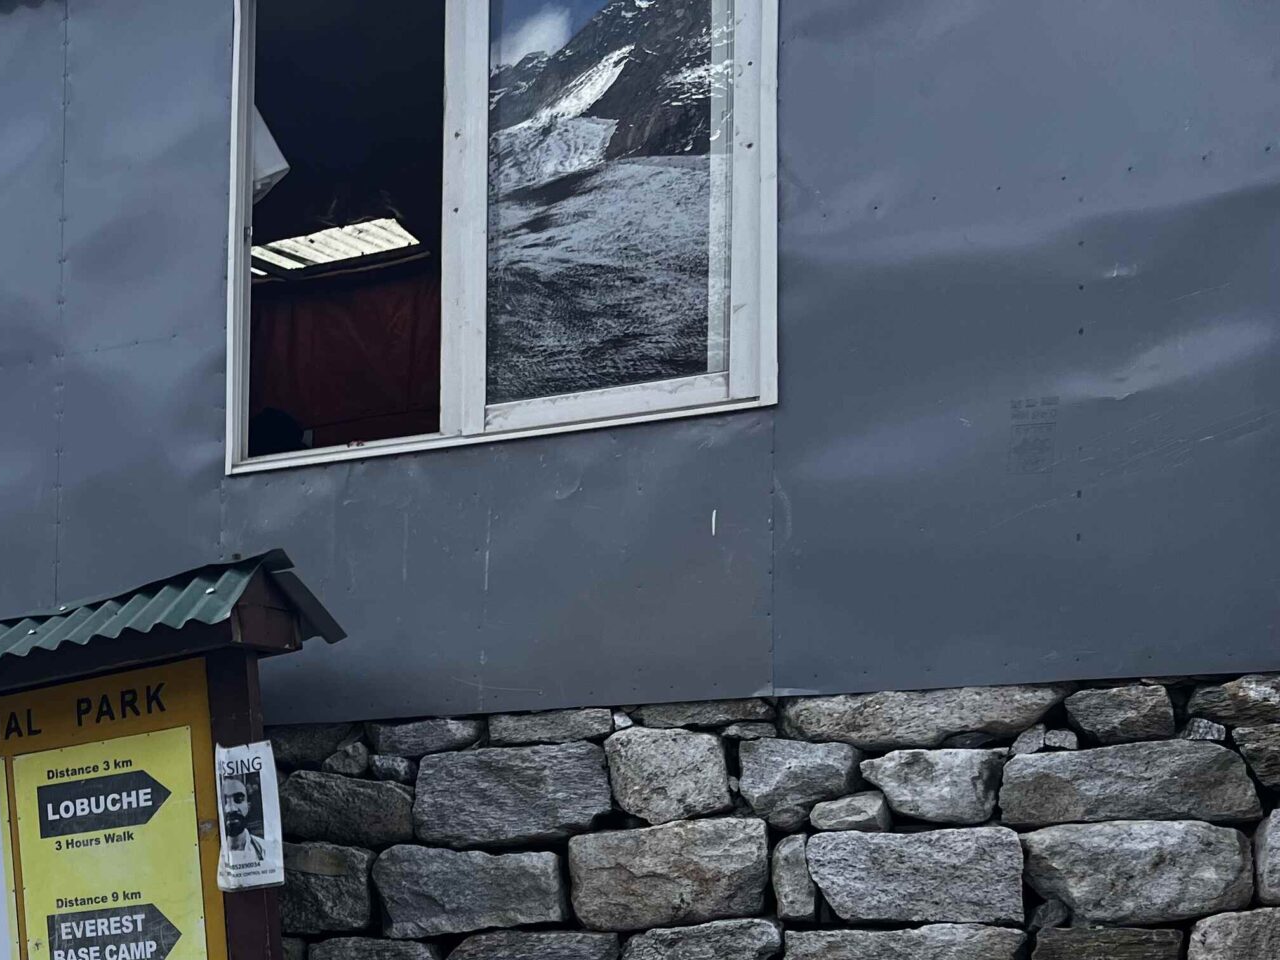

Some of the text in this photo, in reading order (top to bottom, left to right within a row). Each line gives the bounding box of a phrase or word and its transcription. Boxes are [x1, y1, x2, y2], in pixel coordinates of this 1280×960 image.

[76, 682, 168, 727] PARK
[47, 759, 133, 780] Distance 3 km
[47, 788, 153, 821] LOBUCHE
[55, 831, 134, 851] 3 Hours Walk
[56, 890, 142, 909] Distance 9 km
[60, 913, 146, 940] EVEREST
